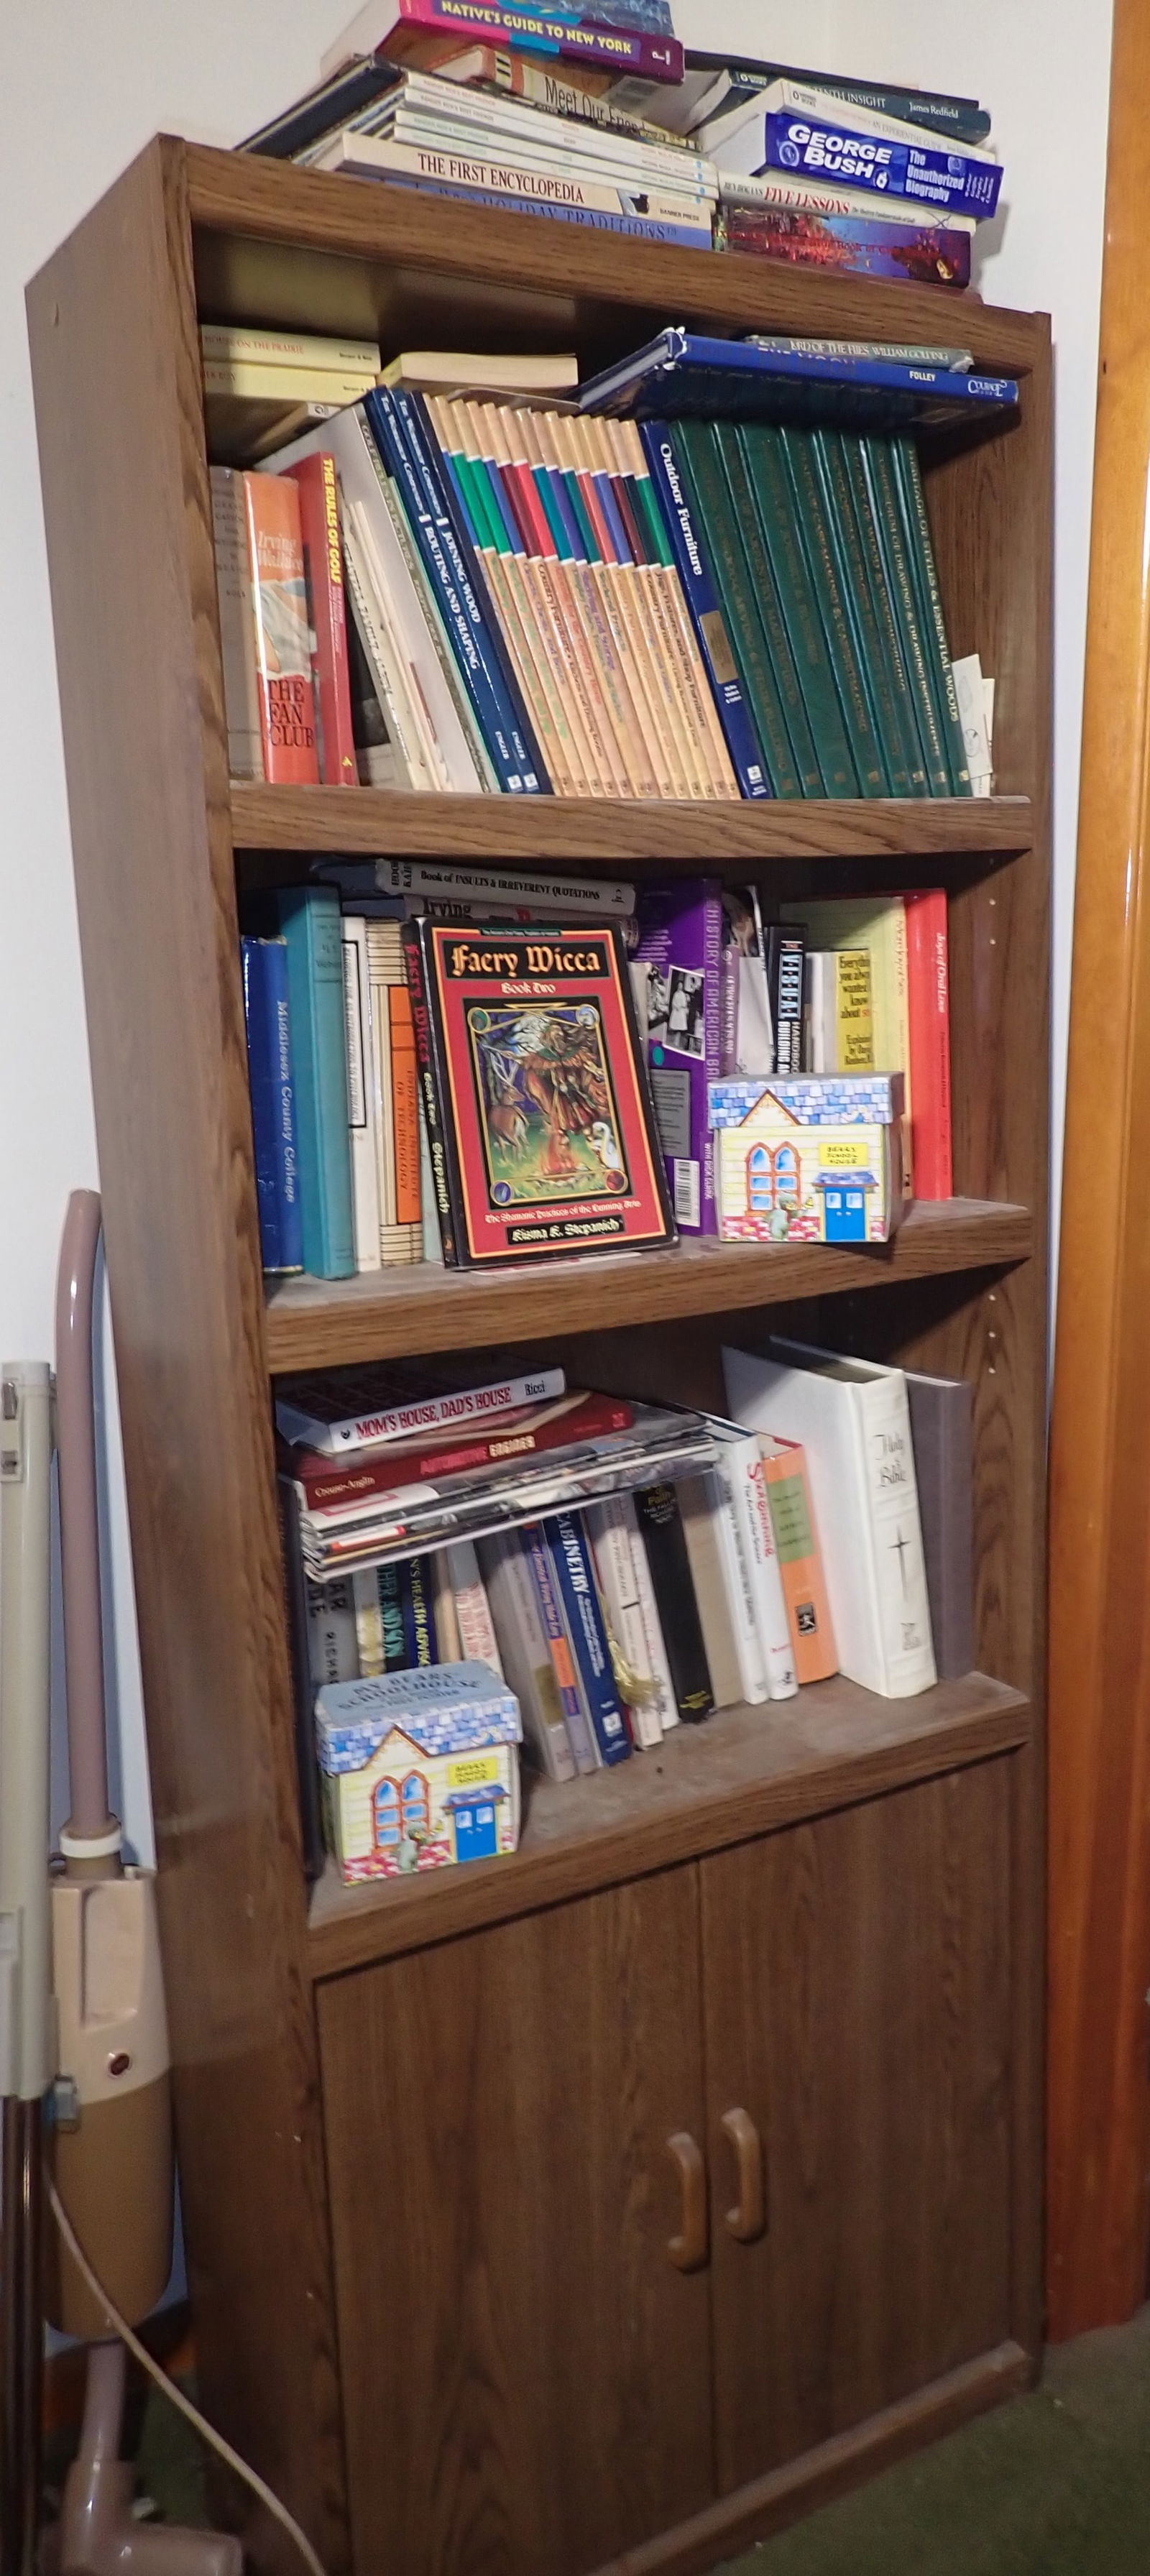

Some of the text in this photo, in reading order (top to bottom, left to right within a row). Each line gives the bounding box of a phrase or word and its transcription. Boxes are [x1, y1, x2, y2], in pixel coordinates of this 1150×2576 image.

[441, 1, 632, 55] NATIVE'S GUIDE TO NEW YORK
[545, 75, 605, 121] Meet Our
[847, 92, 886, 109] INSIGHT
[908, 101, 960, 119] James Redfield
[787, 124, 893, 165] GEORGE
[908, 149, 926, 167] The
[418, 152, 585, 204] THE FIRST ENCYCLOPEDIA
[804, 146, 875, 179] BUSH
[906, 164, 965, 191] Unauthorized
[765, 185, 795, 206] FIVE
[796, 191, 851, 215] LESSONS
[905, 179, 951, 203] Biography
[564, 207, 668, 239] TRADITIONS
[827, 341, 846, 354] THE
[908, 369, 936, 382] FOLLEY
[322, 458, 335, 484] THE
[323, 484, 339, 528] RULES
[660, 442, 705, 576] Outdoor Furniture
[328, 528, 339, 547] OF
[877, 456, 897, 532] OMPENDIUM
[896, 553, 911, 608] DRAWING
[919, 520, 928, 538] OF
[327, 547, 343, 584] GOLF
[442, 528, 481, 624] JOINING WOOD
[922, 540, 937, 587] STYLES
[426, 525, 479, 670] ROUTING AND SHAPING
[535, 563, 555, 604] Country
[932, 604, 951, 672] ESSENTIAL
[268, 679, 305, 704] THE
[944, 674, 960, 722] WOODS
[270, 703, 303, 726] FAN
[271, 724, 314, 748] CLUB
[420, 870, 443, 882] Book
[443, 873, 454, 883] of
[455, 873, 489, 888] INSULTS
[490, 878, 497, 888] &
[498, 879, 550, 895] IRREVERENT
[552, 885, 600, 901] QUOTATIONS
[452, 944, 601, 978] Faery Wicca
[500, 981, 556, 994] Book Two
[706, 908, 719, 1054] HISTORY OF AMERICAN
[781, 954, 800, 1019] VISUAL
[937, 966, 946, 989] Oral
[403, 942, 433, 1063] Faery Wicca
[840, 1007, 860, 1019] about
[937, 989, 947, 1013] Love
[778, 1021, 791, 1075] BUILDING AN
[791, 1021, 801, 1074] HANDBOO
[276, 1000, 297, 1203] Middlesex County College
[423, 1072, 434, 1103] Book
[431, 1141, 451, 1215] Stepanich
[564, 1218, 620, 1236] Stepanich
[354, 1380, 546, 1439] MOM'S HOUSE, DAD'S HOUSE Ricci
[872, 1432, 904, 1460] Holy
[877, 1460, 908, 1489] Bible
[556, 1512, 590, 1593] CABINETRY
[380, 1601, 402, 1629] AND
[411, 1579, 428, 1625] HEALTH
[382, 1629, 405, 1658] SON
